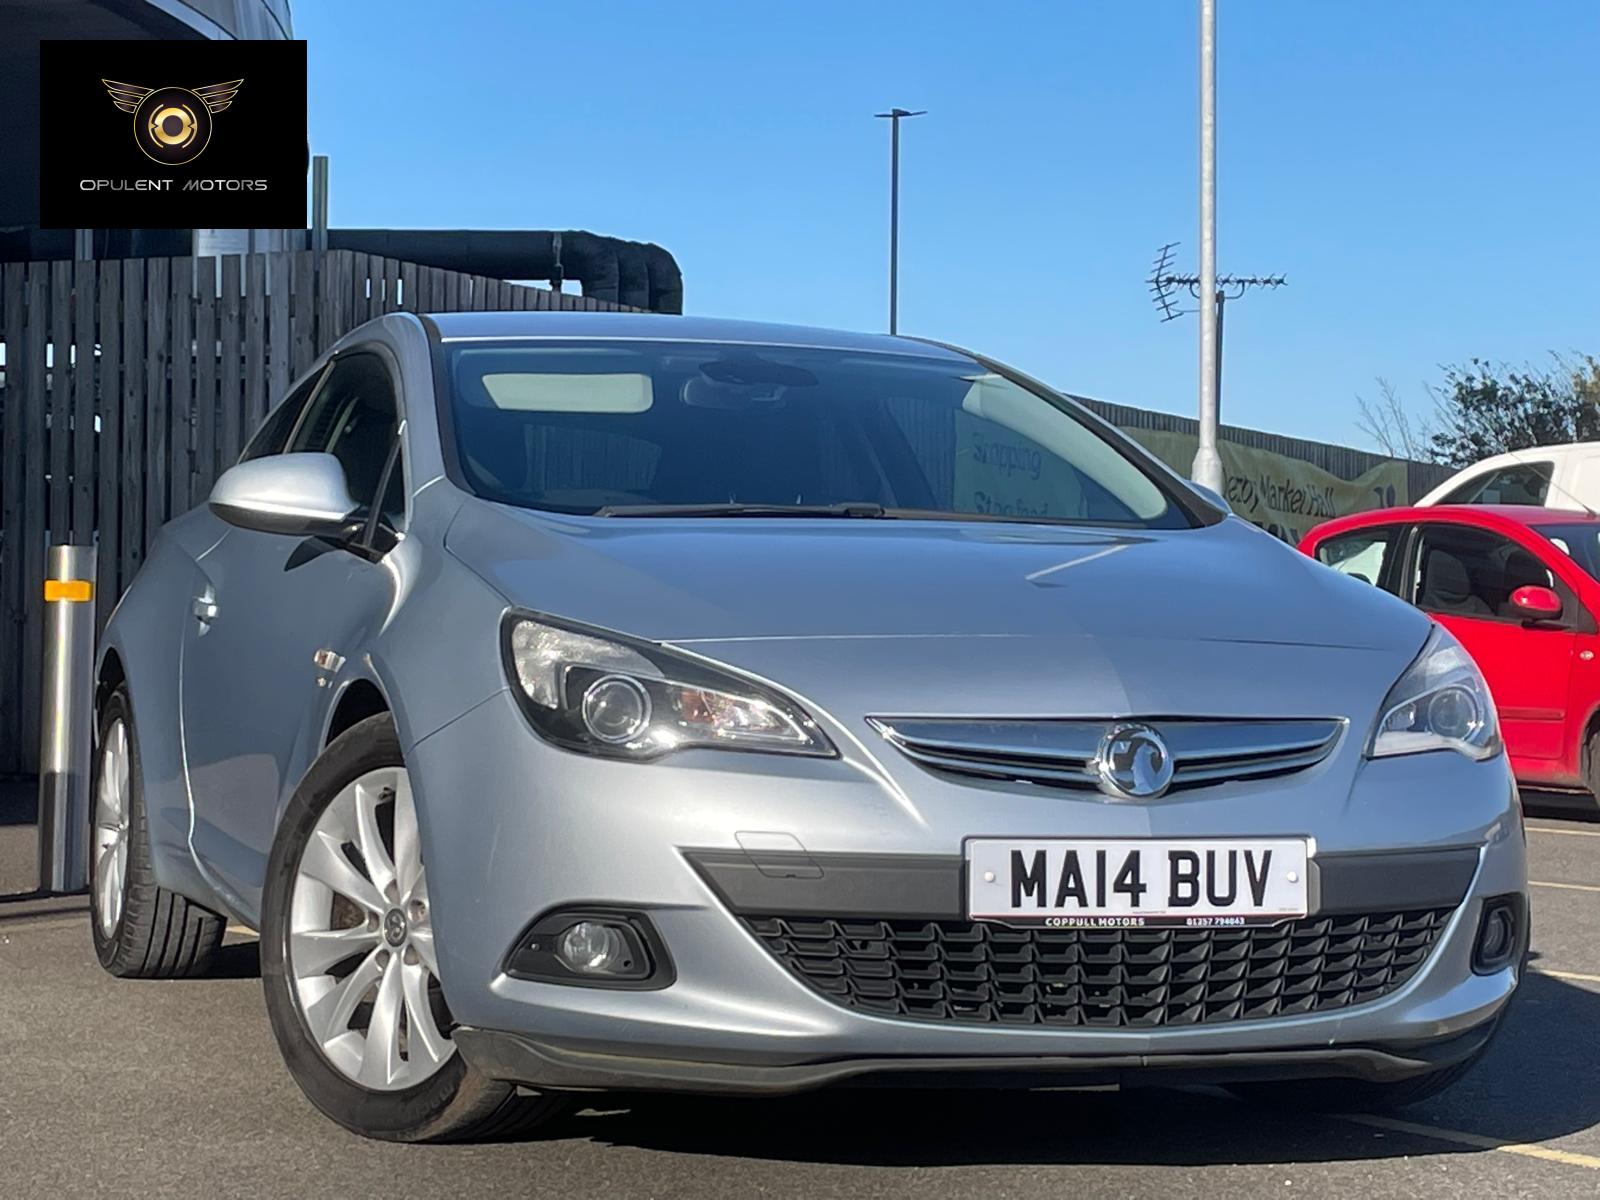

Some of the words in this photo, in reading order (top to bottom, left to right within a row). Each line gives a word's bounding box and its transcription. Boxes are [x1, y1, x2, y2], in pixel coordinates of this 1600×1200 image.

[1010, 849, 1147, 908] MA14
[1167, 849, 1273, 908] BUV
[1045, 917, 1097, 927] COPPULL
[1098, 917, 1145, 927] MOTORS
